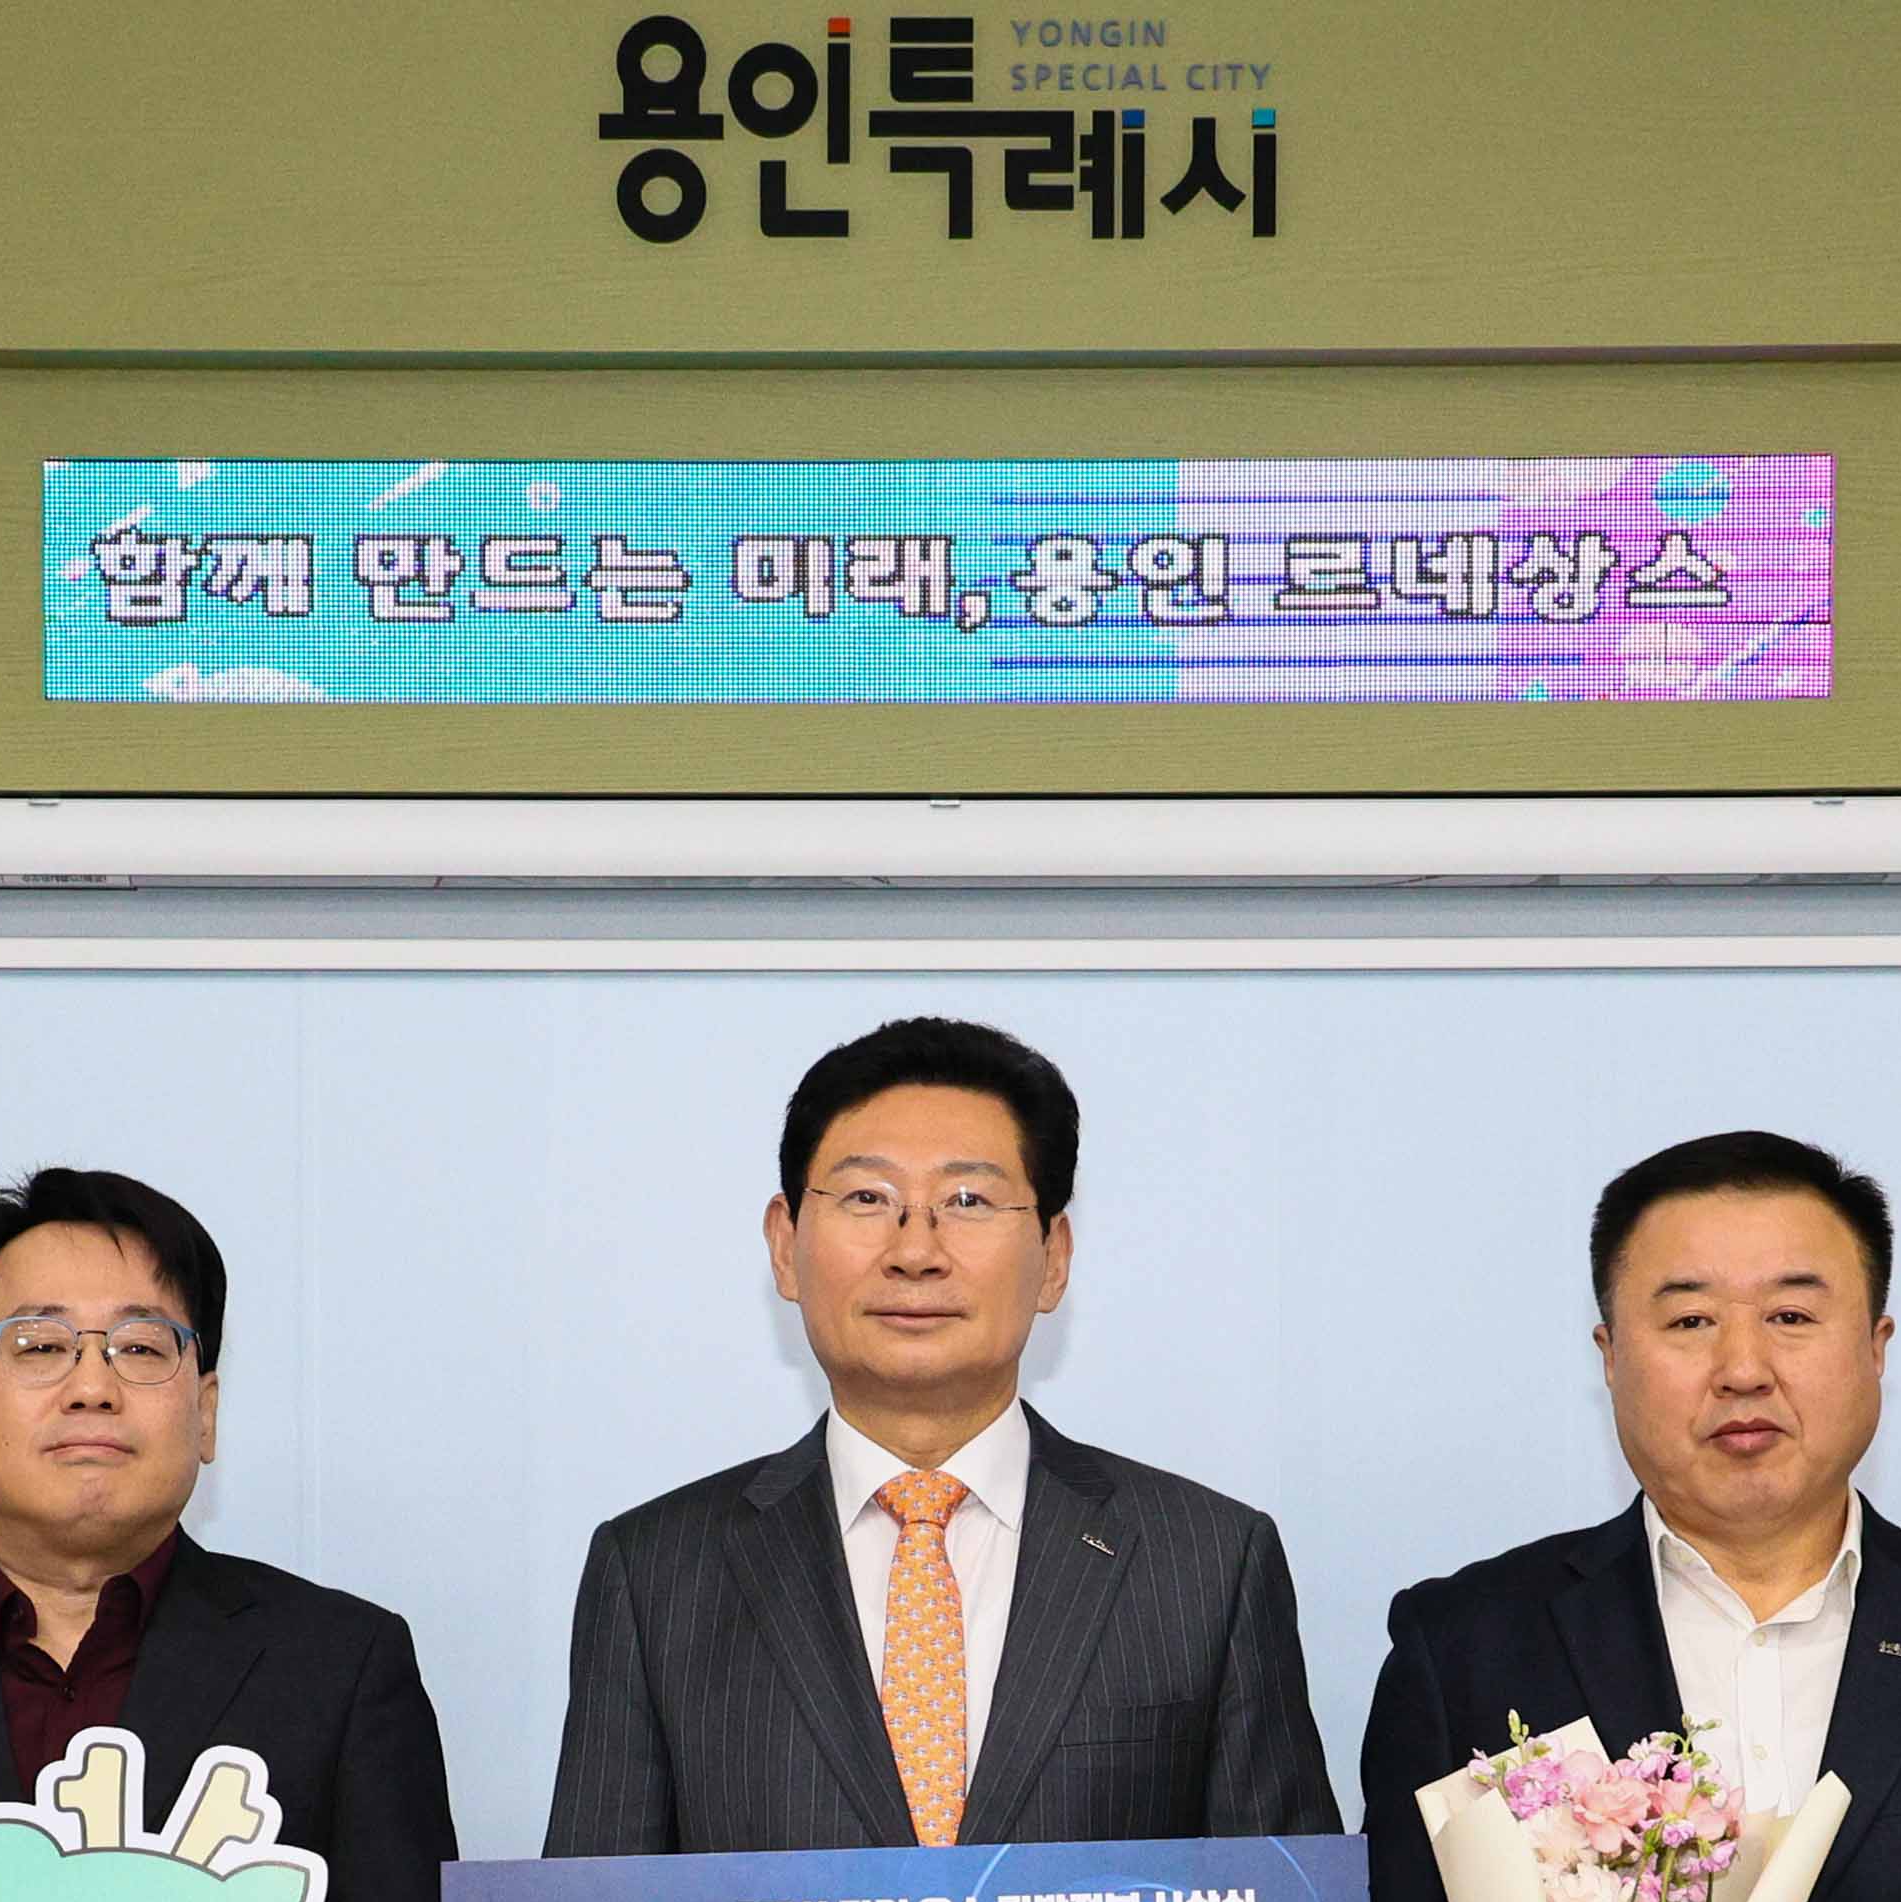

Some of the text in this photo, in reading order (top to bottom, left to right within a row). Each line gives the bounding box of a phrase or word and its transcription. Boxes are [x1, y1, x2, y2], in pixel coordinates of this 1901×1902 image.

[1011, 20, 1167, 47] YONGIN
[1011, 63, 1272, 91] SPECIAL CITY
[599, 15, 1277, 244] 용인특례시
[90, 528, 314, 626] 함께
[355, 535, 692, 622] 만드는
[1274, 532, 1732, 624] 르네상스
